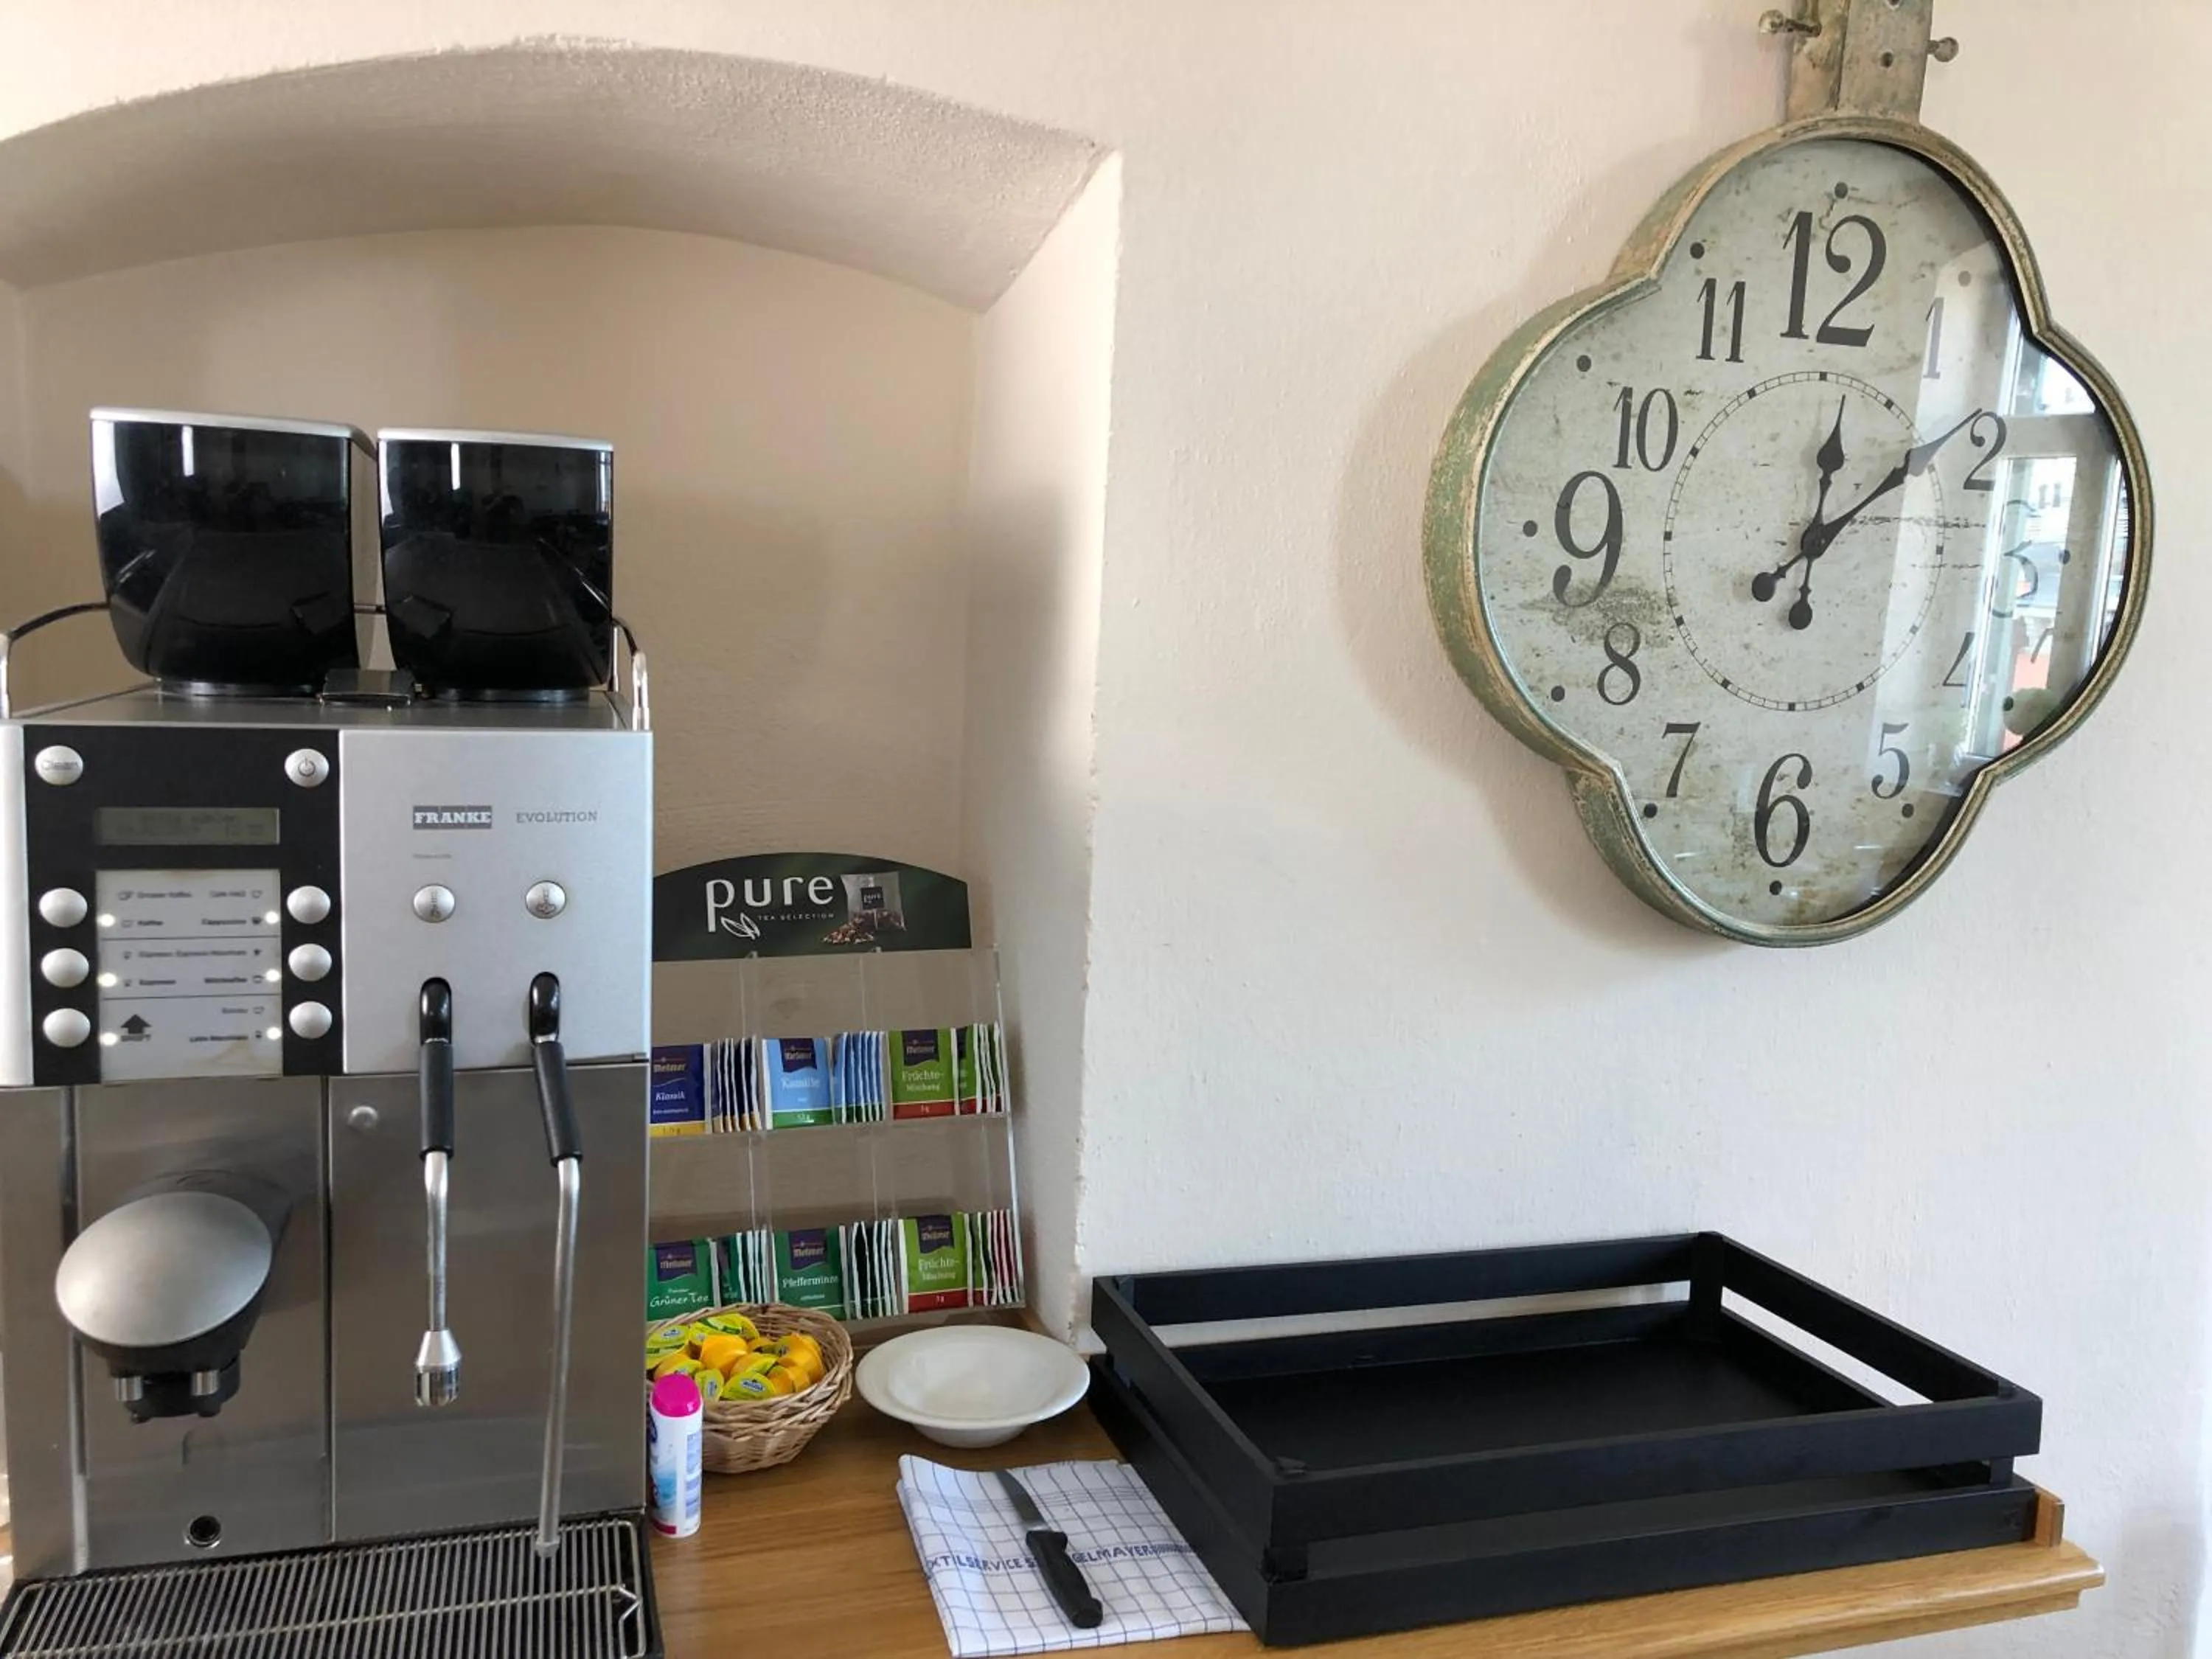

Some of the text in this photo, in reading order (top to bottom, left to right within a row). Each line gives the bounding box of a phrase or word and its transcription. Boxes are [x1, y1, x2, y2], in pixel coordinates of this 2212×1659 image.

[1695, 277, 1747, 364] 11
[1779, 211, 1887, 347] 12
[1921, 296, 1945, 380] 1
[1612, 386, 1680, 473] 10
[1962, 410, 2007, 492] 2
[1552, 470, 1623, 608] 9
[1596, 621, 1642, 706] 8
[1660, 722, 1702, 799] 7
[1870, 723, 1910, 799] 5
[413, 810, 598, 825] FRANKE EVOLUTION
[1752, 752, 1814, 868] 6
[705, 875, 834, 933] pure
[650, 1292, 709, 1308] Grüner Tee
